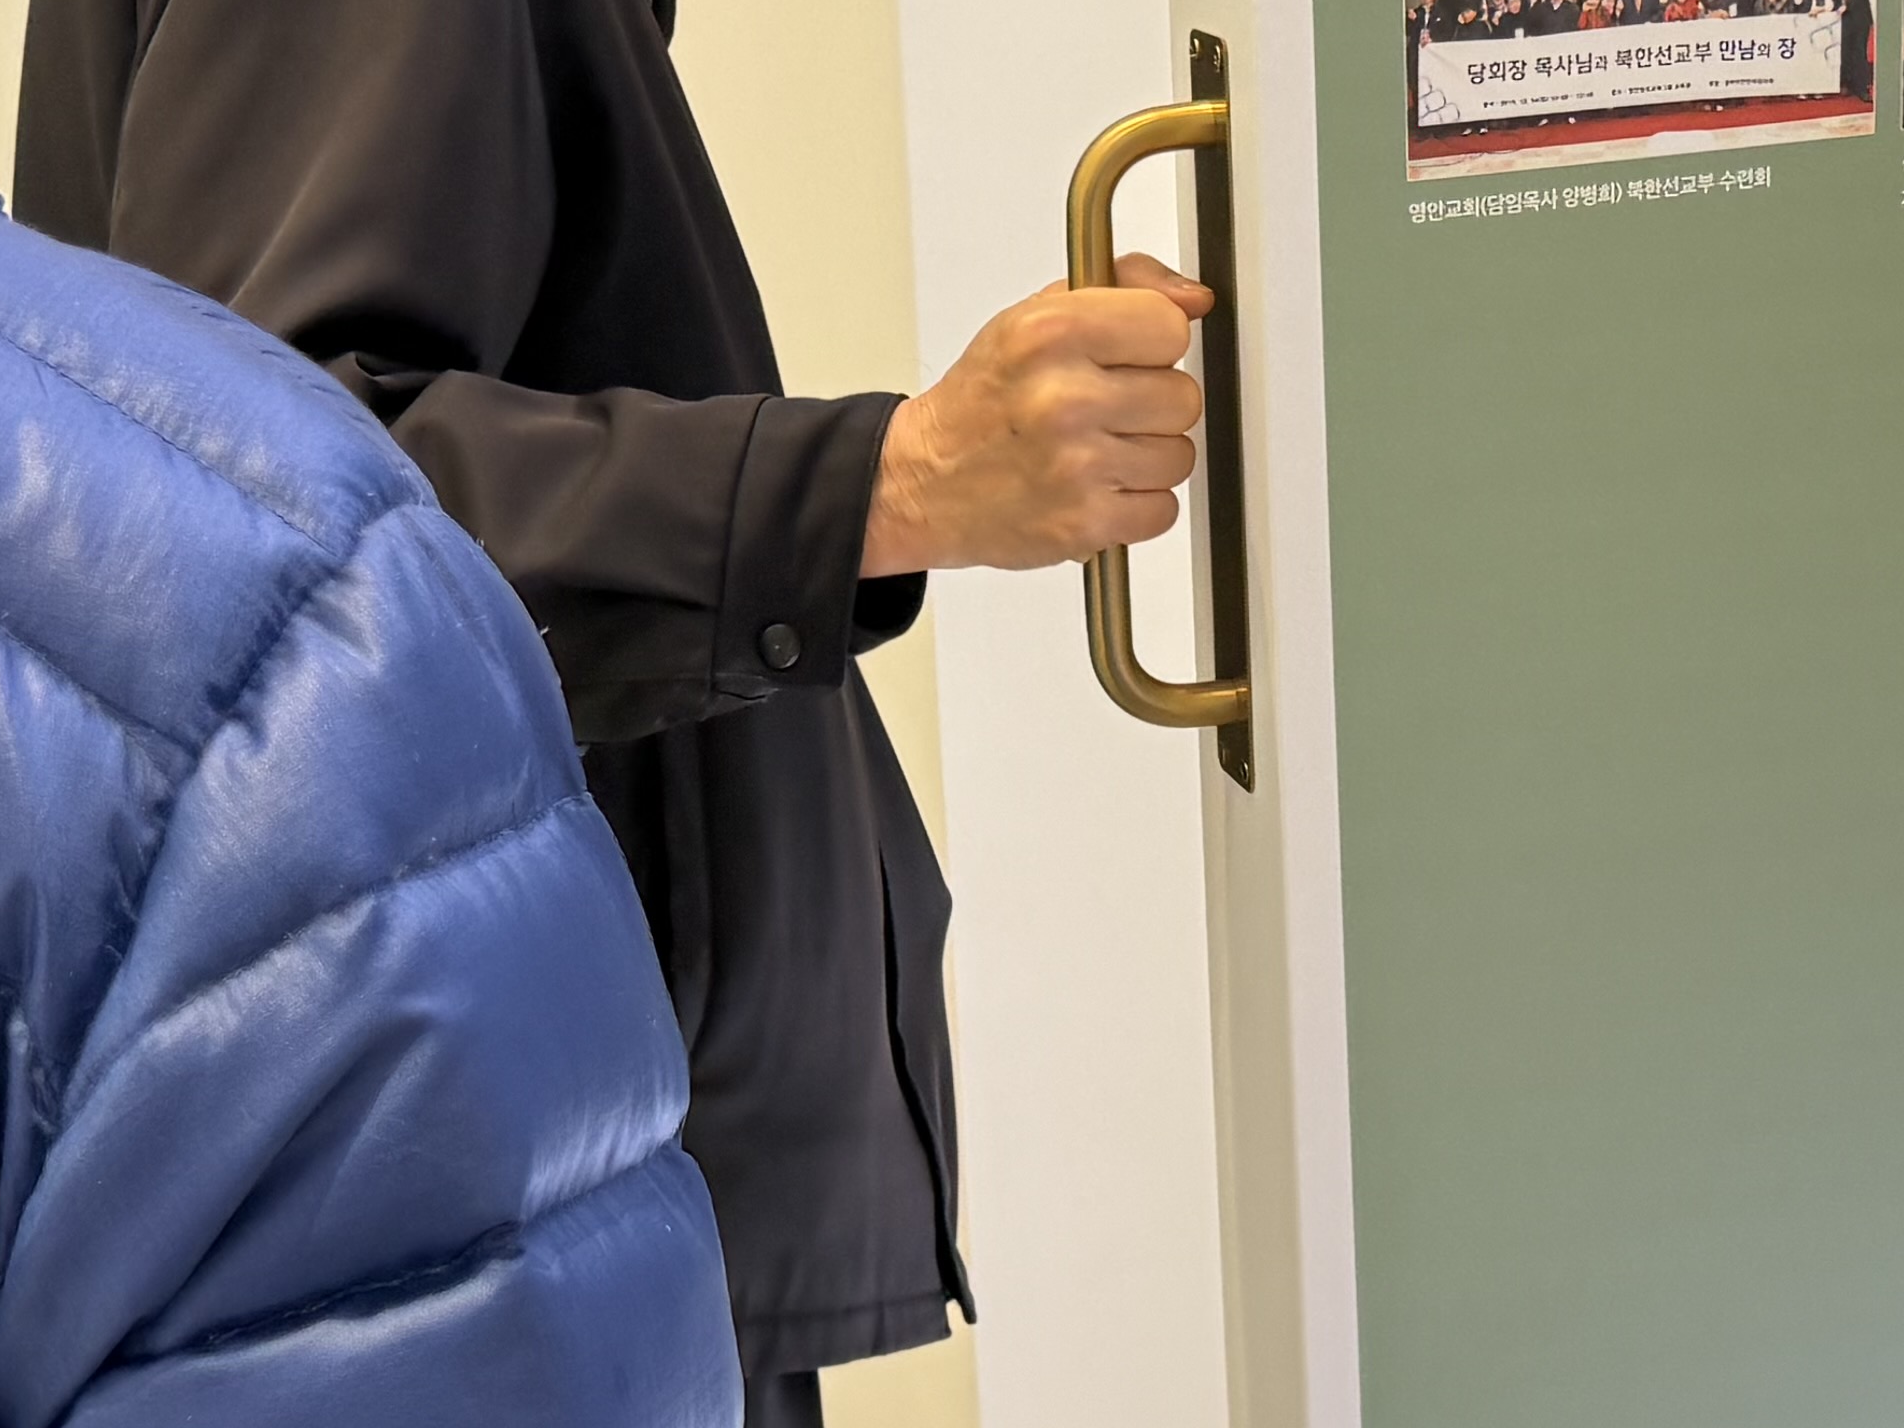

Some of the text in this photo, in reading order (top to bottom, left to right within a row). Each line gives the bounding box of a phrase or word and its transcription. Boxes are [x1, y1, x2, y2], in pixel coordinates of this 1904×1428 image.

[1466, 36, 1797, 85] 당회장 목사님과 북한선교부 만남의 장
